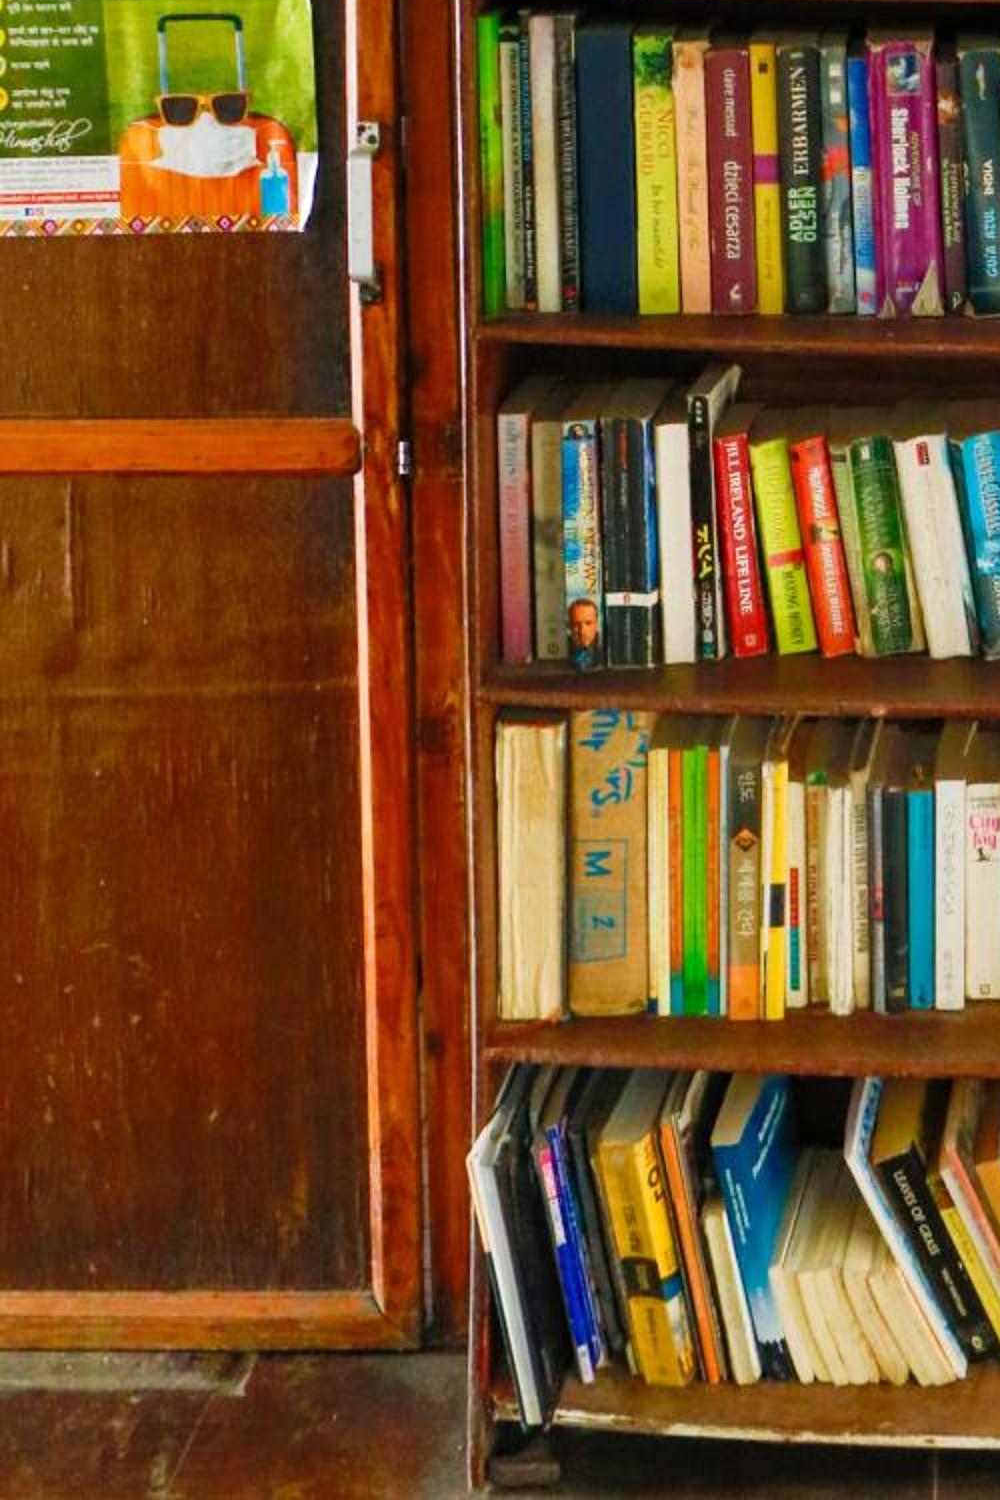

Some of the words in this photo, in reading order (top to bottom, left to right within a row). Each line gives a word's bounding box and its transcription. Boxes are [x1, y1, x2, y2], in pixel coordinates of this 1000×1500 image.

[723, 68, 737, 97] claire
[724, 98, 737, 137] messud
[789, 67, 809, 176] ERBARMEN
[890, 107, 910, 175] Sherlock
[723, 160, 742, 201] dzieci
[982, 159, 994, 196] INDIA
[787, 188, 802, 242] ADLER
[802, 186, 816, 242] OLSEN
[894, 178, 910, 229] Holmes
[725, 205, 741, 259] cesarza
[982, 208, 997, 239] AZUL
[724, 441, 739, 468] JILL
[728, 472, 746, 540] IRELAND
[697, 525, 712, 578] インド
[734, 546, 748, 576] LIFE
[738, 580, 752, 616] LINE
[737, 772, 753, 803] 인도
[584, 851, 612, 877] M
[919, 1222, 940, 1256] GRASS
